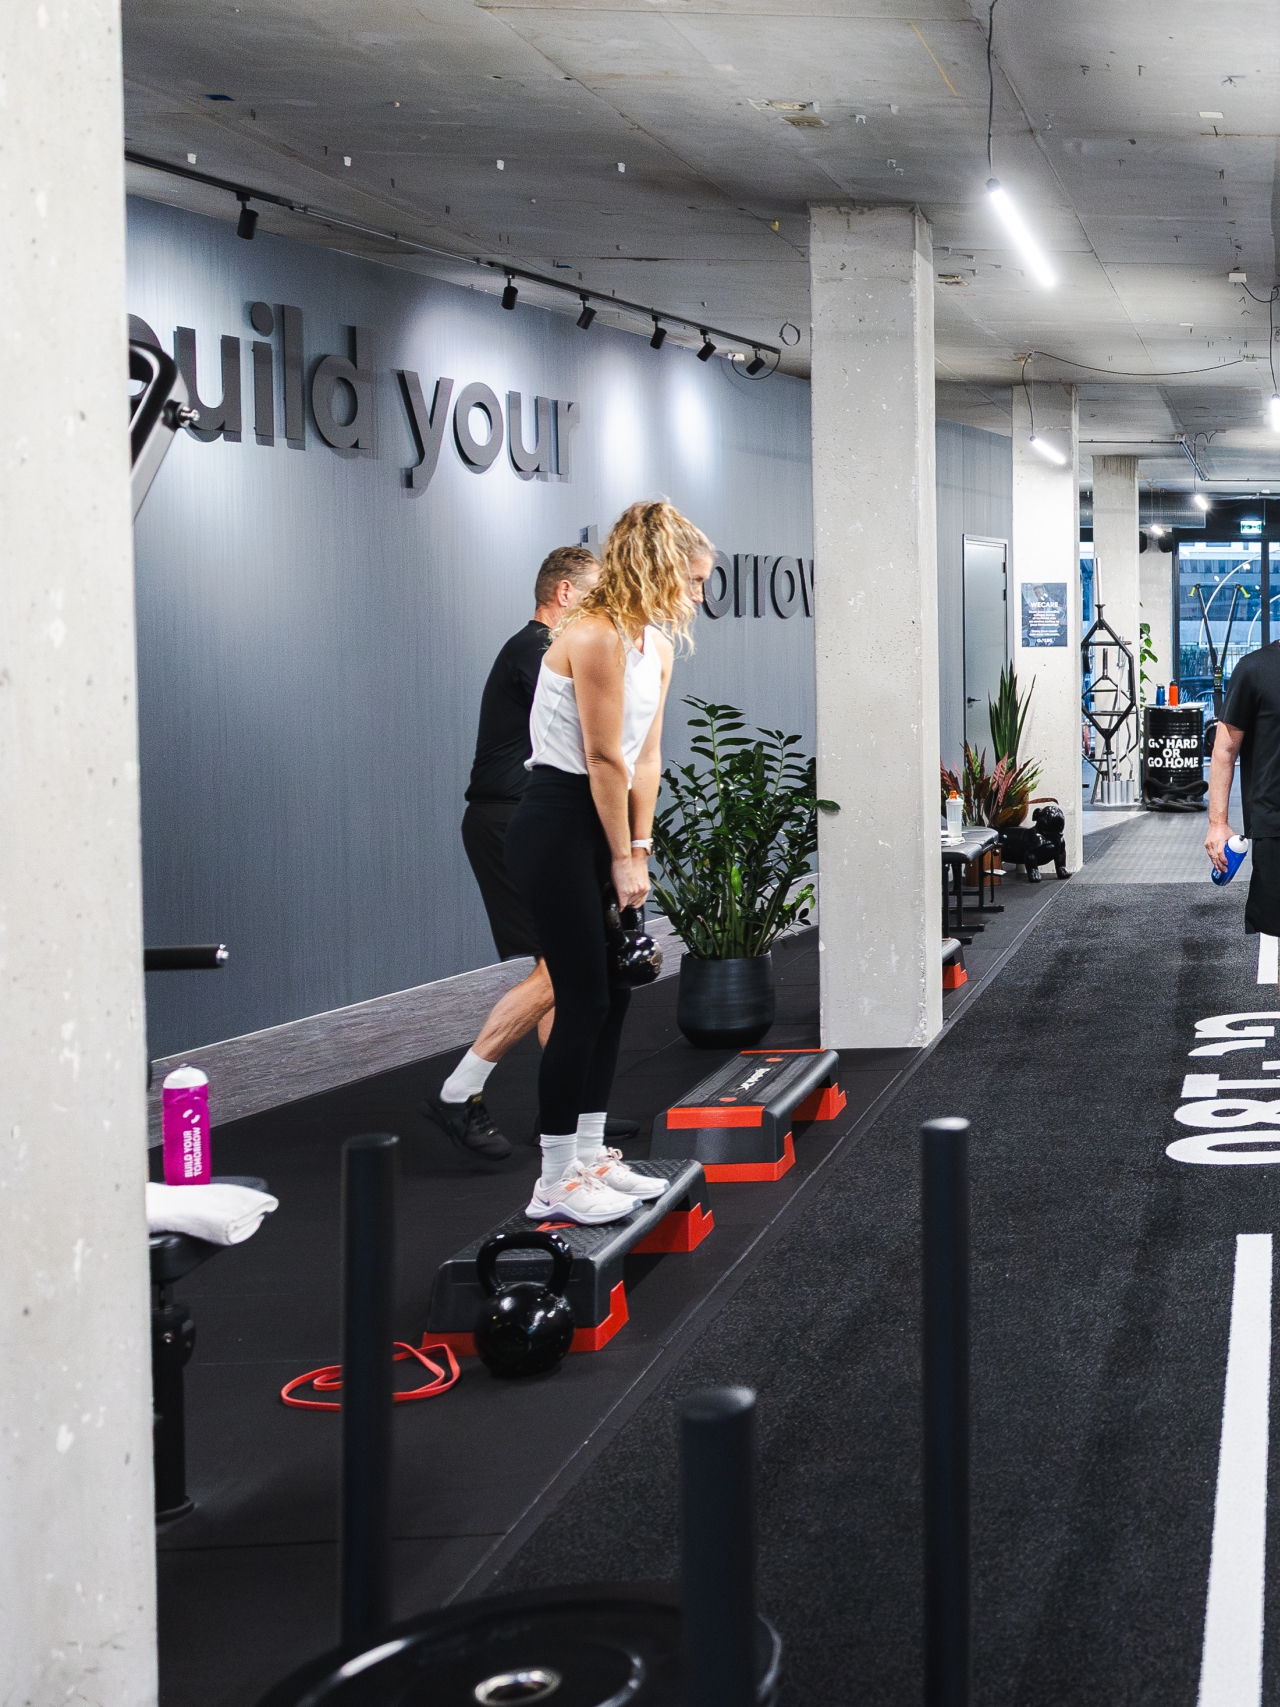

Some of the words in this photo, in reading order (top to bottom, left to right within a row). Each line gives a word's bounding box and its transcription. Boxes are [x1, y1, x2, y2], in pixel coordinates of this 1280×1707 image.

[397, 369, 579, 494] your
[1162, 748, 1181, 758] OR
[1166, 738, 1198, 749] HARD
[1147, 757, 1163, 767] GO
[1165, 757, 1199, 768] HOME
[183, 1130, 193, 1153] YOUR
[192, 1127, 203, 1177] TOMORROW
[183, 1154, 194, 1178] BUILD
